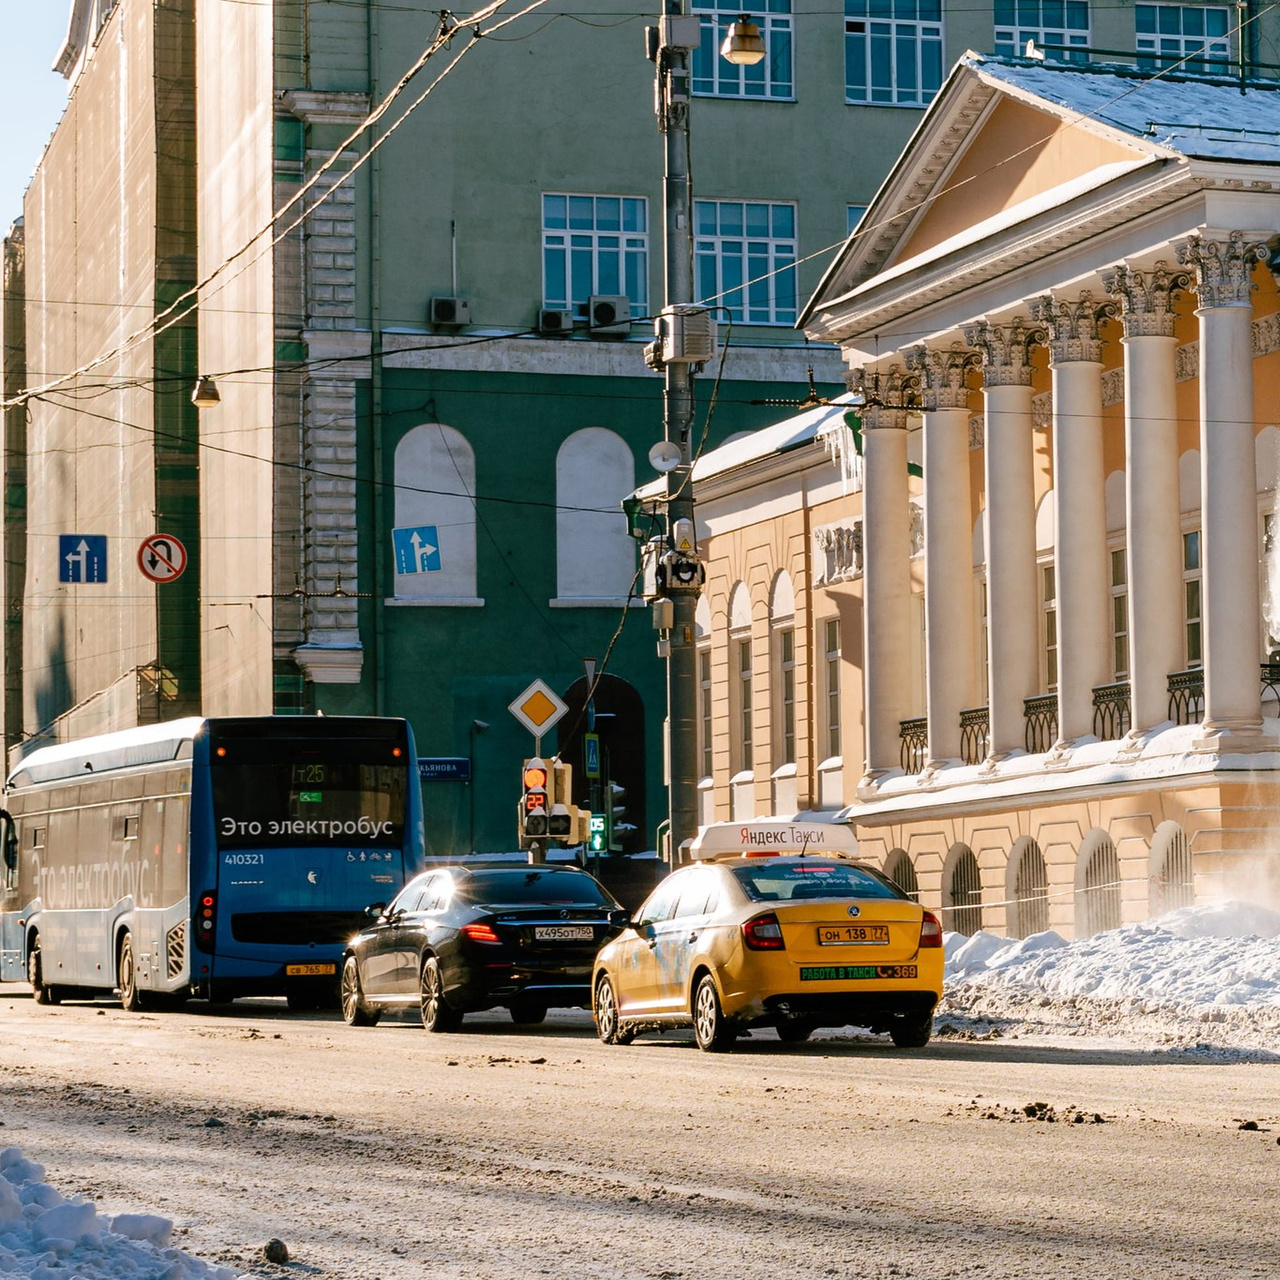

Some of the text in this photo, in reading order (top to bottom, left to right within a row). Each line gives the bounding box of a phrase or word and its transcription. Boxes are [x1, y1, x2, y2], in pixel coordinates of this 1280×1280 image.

[418, 764, 457, 772] КЬЯНОВА
[527, 794, 544, 810] 22
[221, 816, 393, 838] Это электробус
[590, 818, 604, 831] 05
[740, 827, 825, 845] Яндекс Такси
[225, 854, 264, 865] 410321
[846, 928, 867, 940] 138
[873, 927, 884, 937] 77
[304, 965, 320, 974] 765
[802, 966, 916, 979] РАБОТА В ТАКСИ 369
